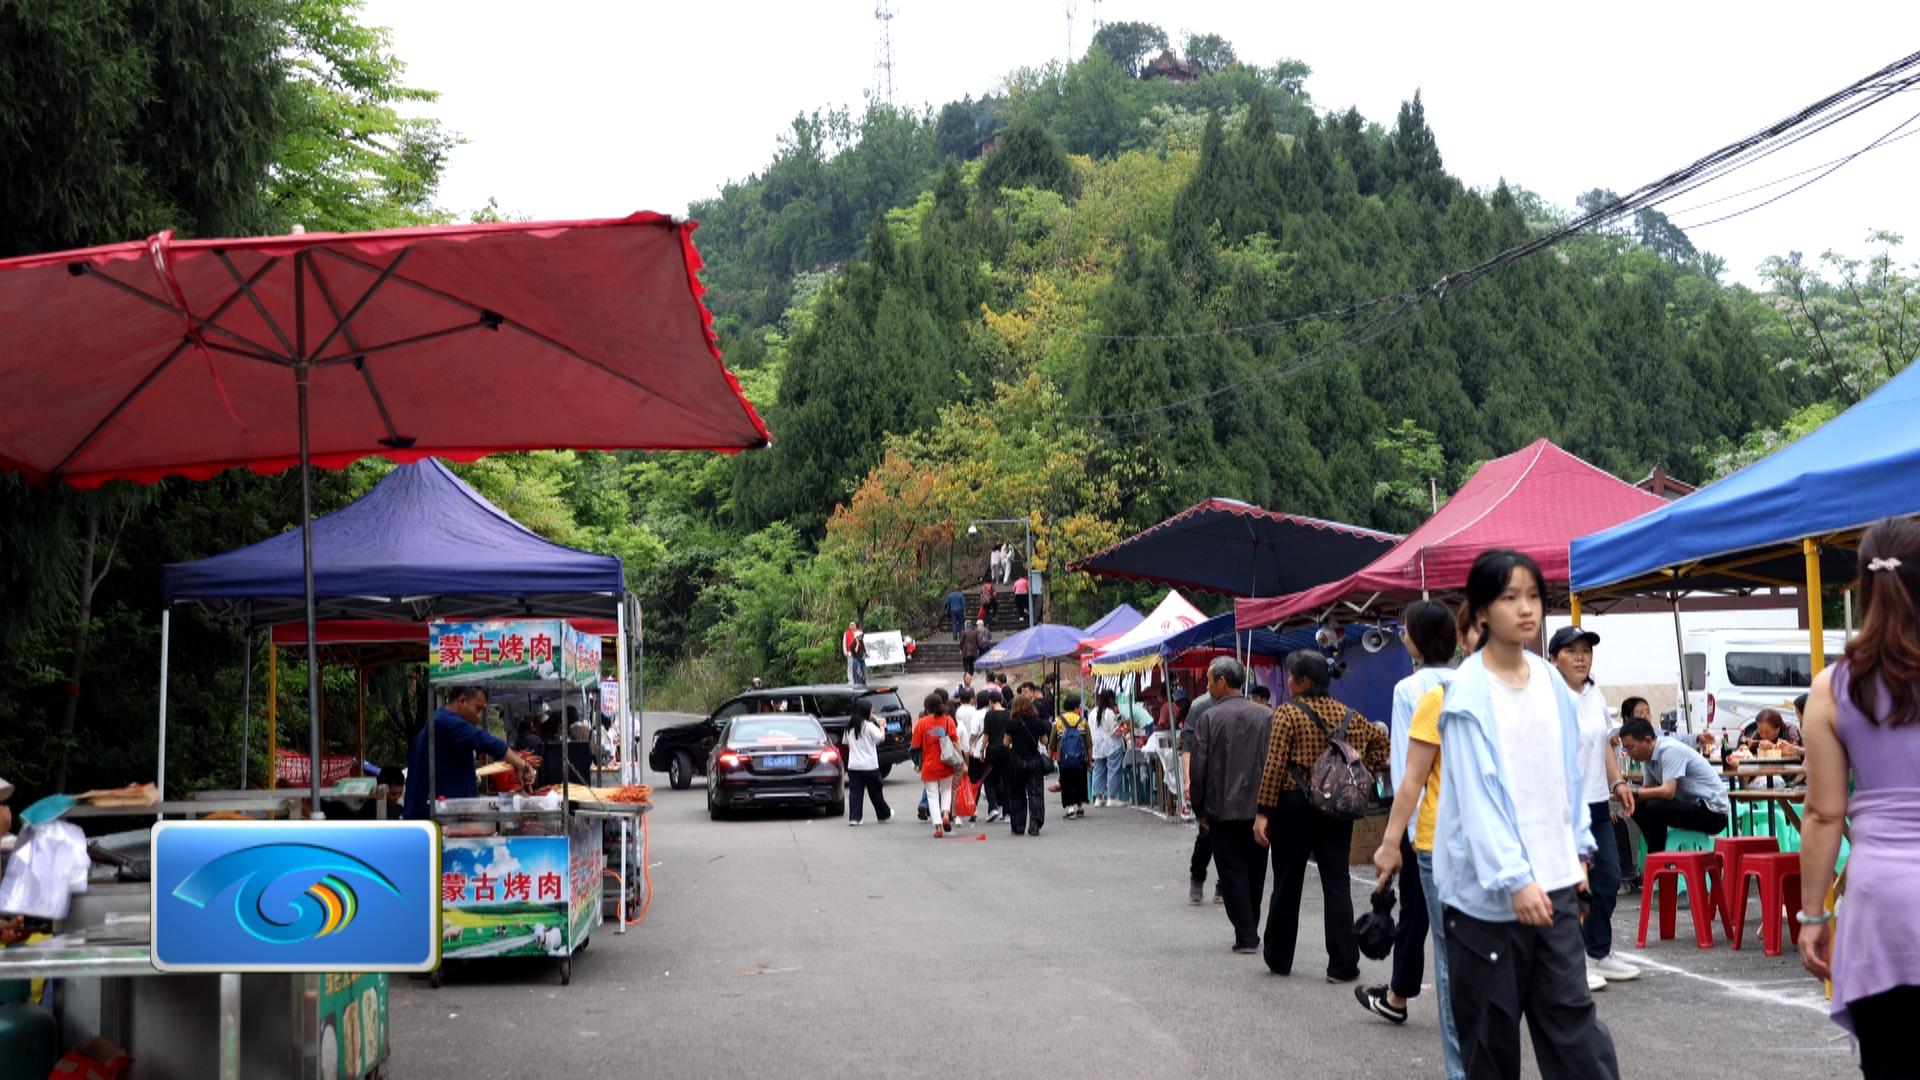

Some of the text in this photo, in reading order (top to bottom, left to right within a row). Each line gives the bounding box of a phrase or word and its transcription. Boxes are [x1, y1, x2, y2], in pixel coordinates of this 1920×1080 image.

[438, 633, 553, 664] 蒙古烤肉
[441, 871, 562, 902] 蒙古烤肉
